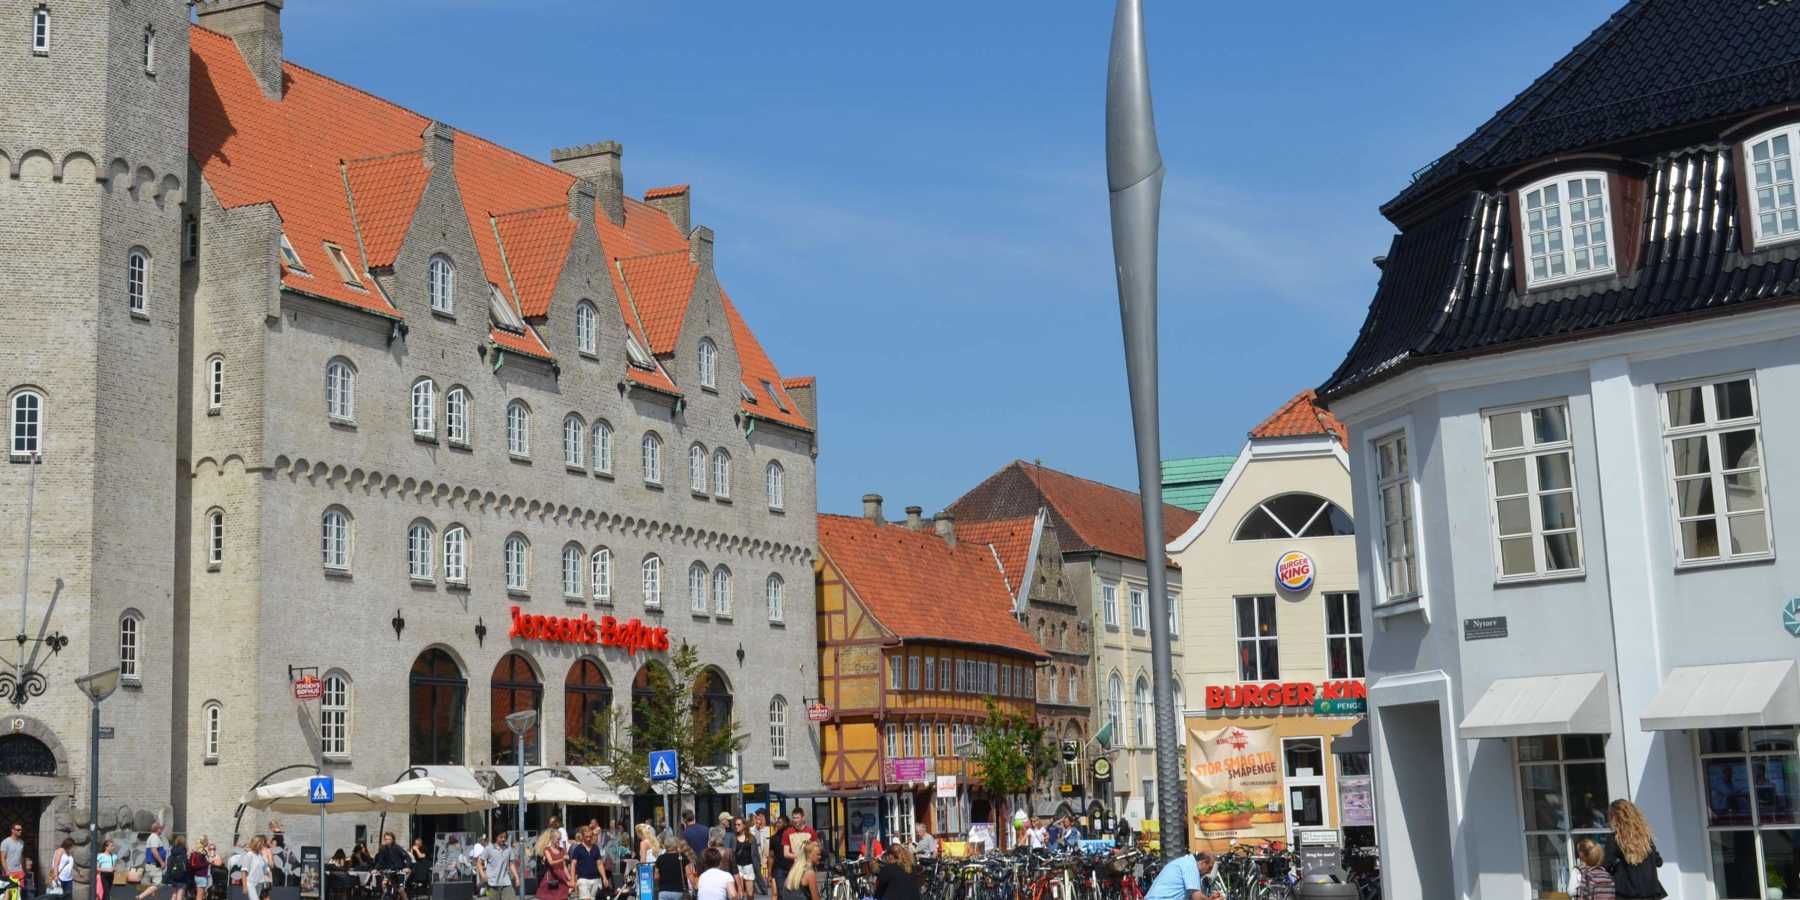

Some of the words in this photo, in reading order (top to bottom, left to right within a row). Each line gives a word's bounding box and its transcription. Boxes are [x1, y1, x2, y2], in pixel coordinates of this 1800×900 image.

[1280, 558, 1308, 572] BURGER
[1281, 565, 1309, 581] KING
[510, 606, 598, 643] Jensen's
[1473, 620, 1497, 629] Nytorv
[1206, 682, 1314, 709] BURGER
[12, 719, 24, 730] 19
[1197, 760, 1222, 777] STOR
[1224, 753, 1256, 771] SMAG
